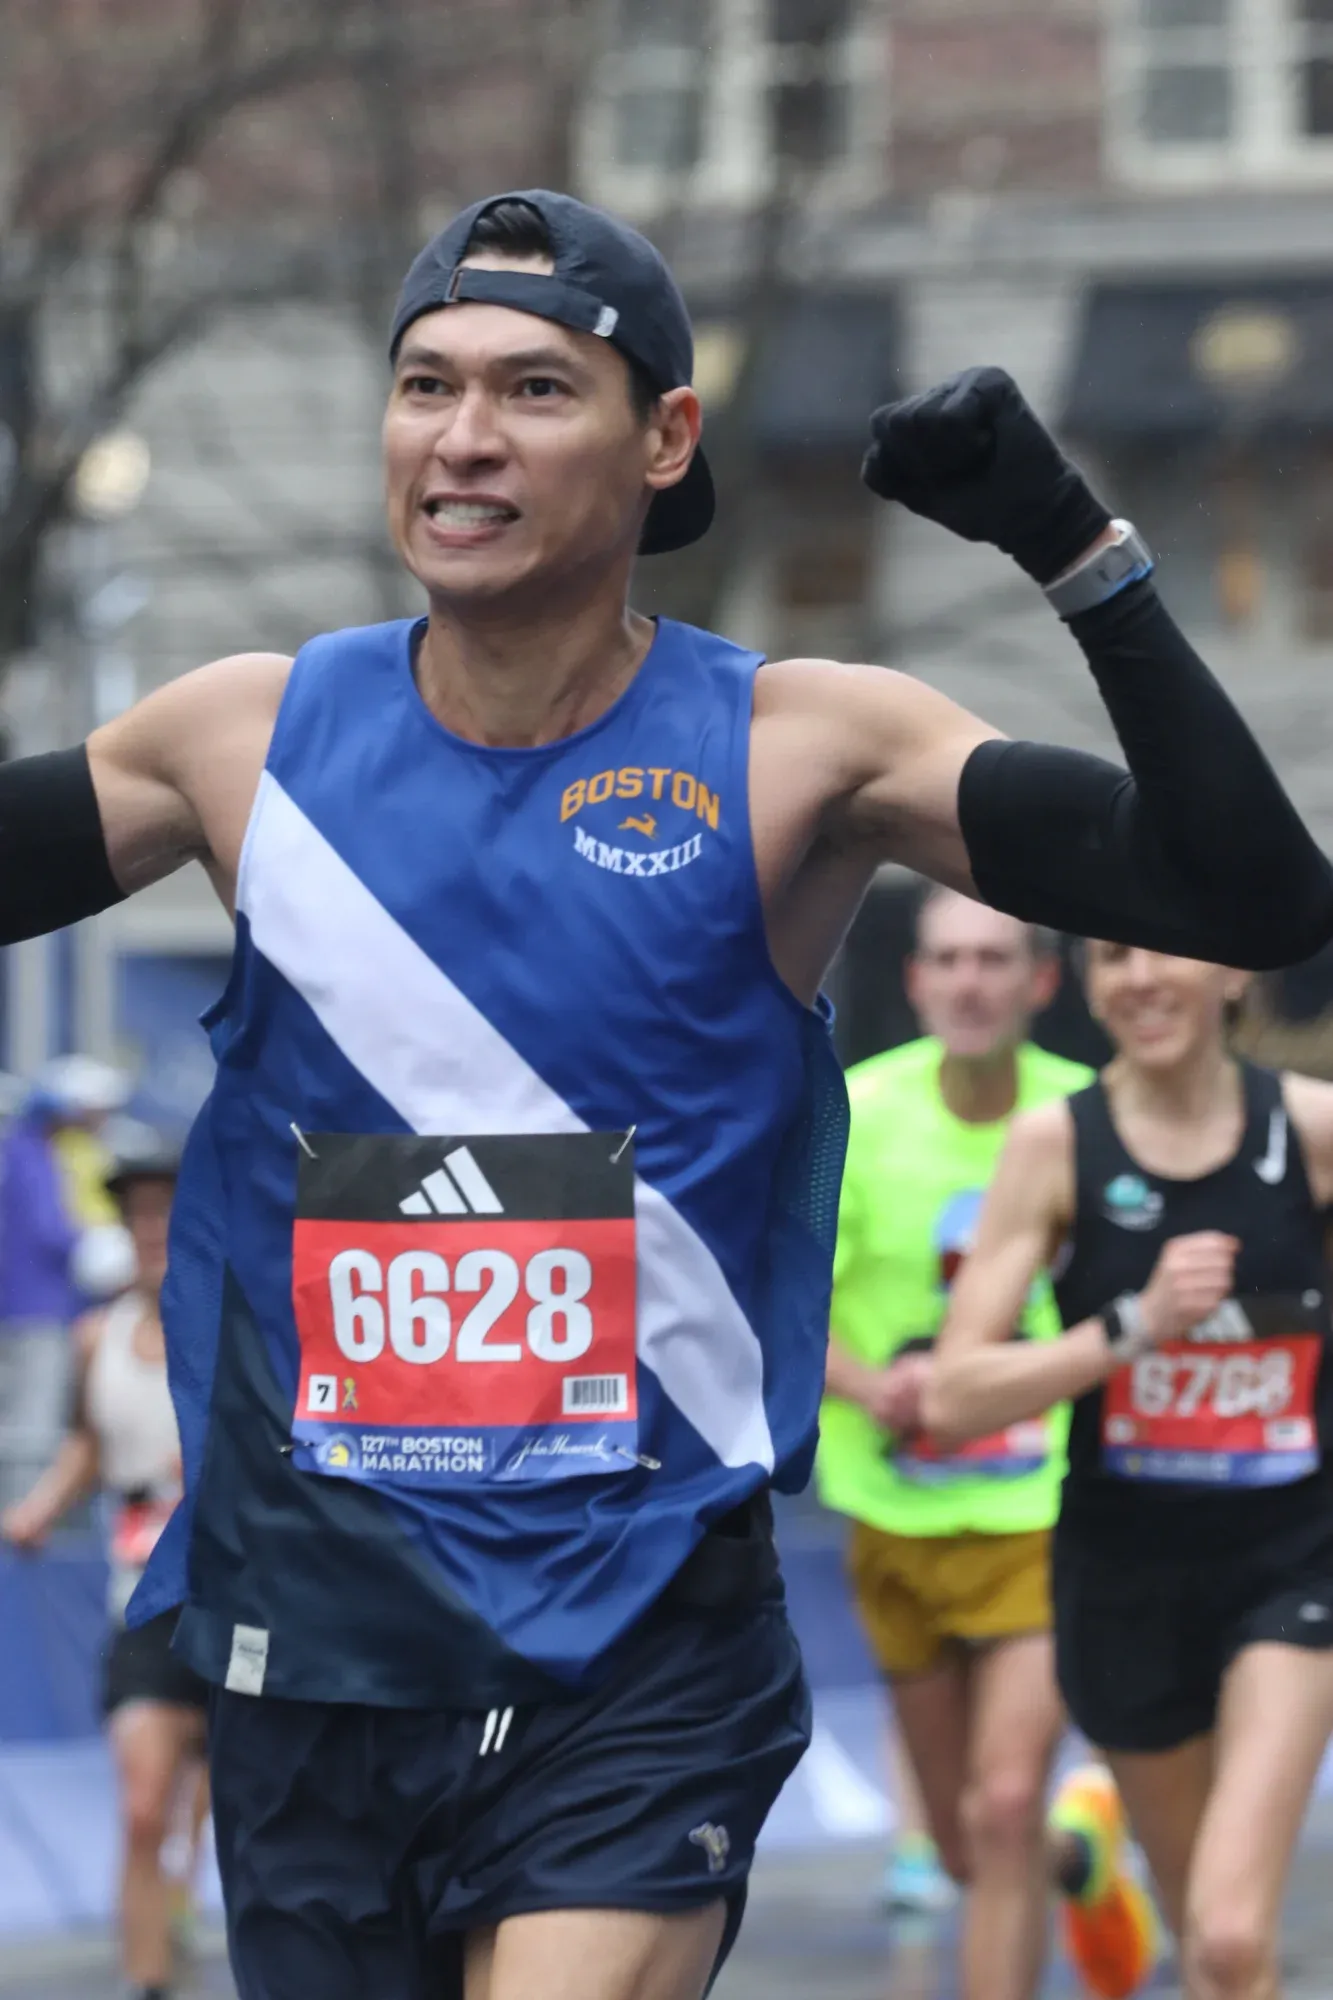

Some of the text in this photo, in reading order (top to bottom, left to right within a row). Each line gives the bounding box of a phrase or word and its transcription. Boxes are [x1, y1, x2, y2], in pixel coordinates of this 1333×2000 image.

[560, 767, 720, 831] BOSTON
[573, 825, 703, 877] MMXXIII
[329, 1248, 593, 1364] 6628
[317, 1384, 330, 1403] 7
[361, 1453, 483, 1472] MARATHON
[401, 1436, 483, 1454] BOSTON
